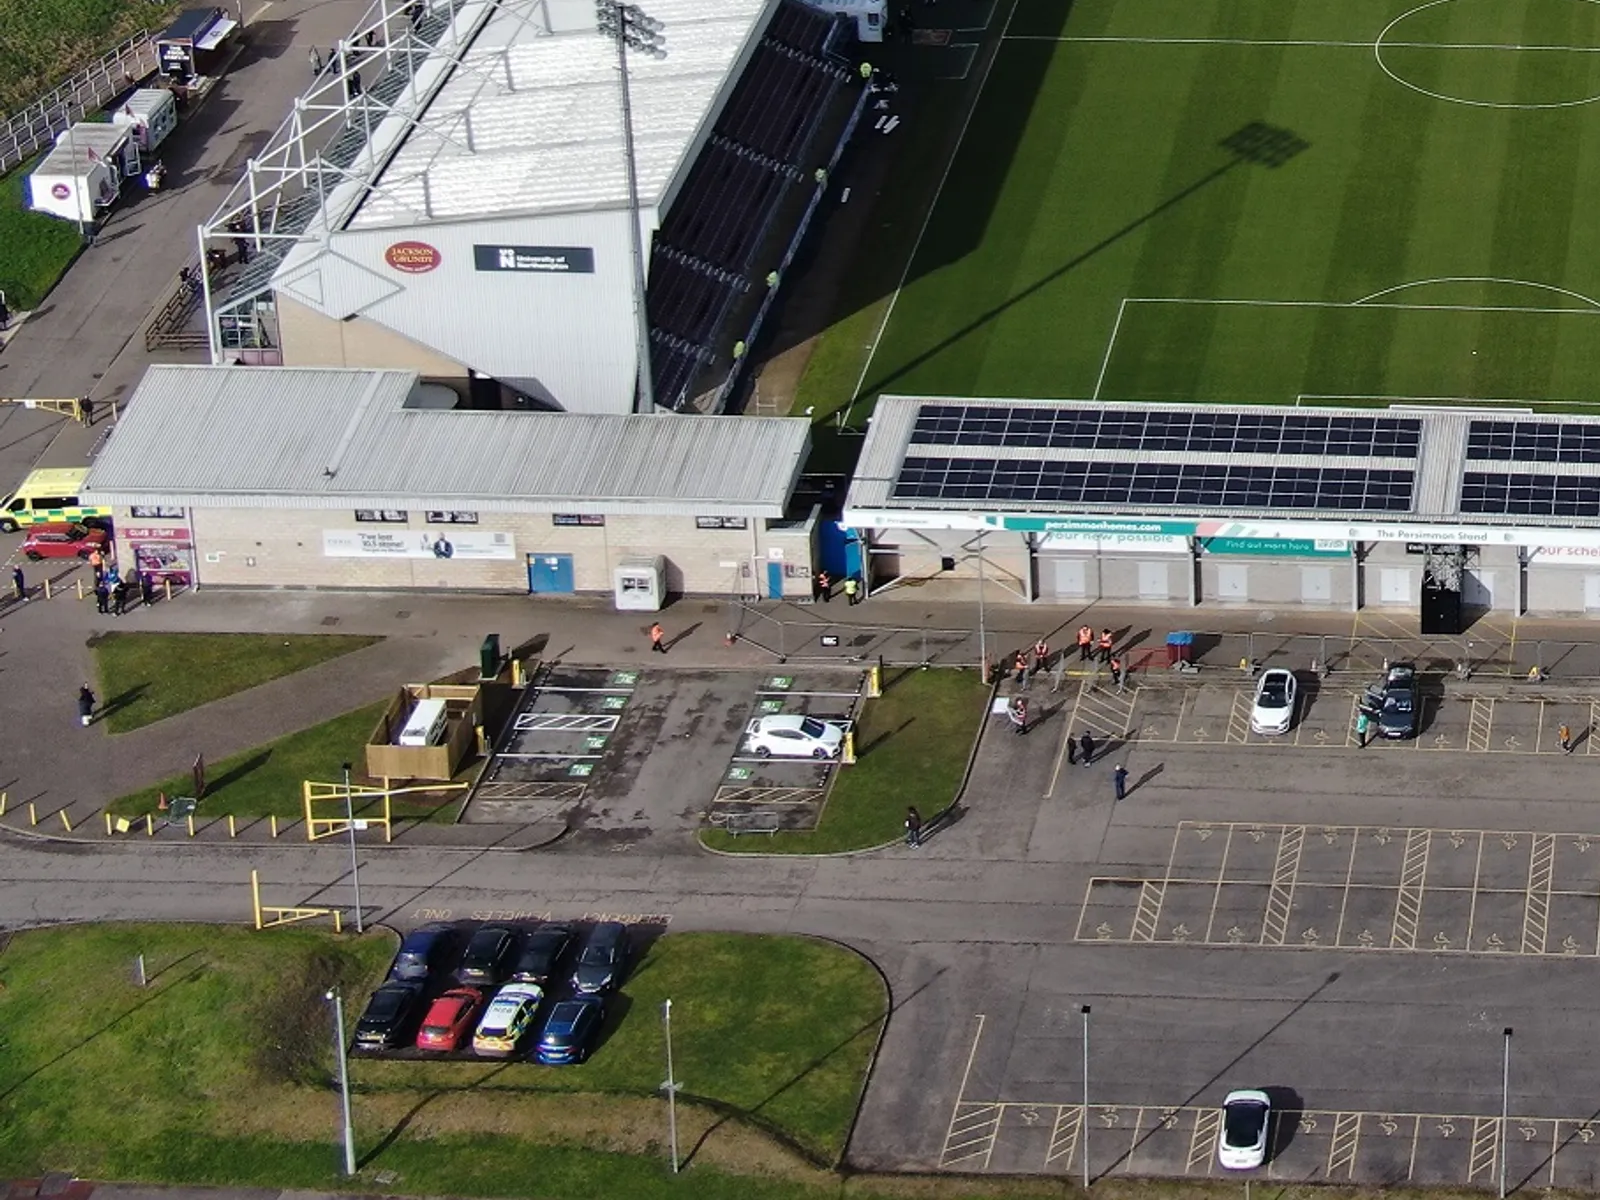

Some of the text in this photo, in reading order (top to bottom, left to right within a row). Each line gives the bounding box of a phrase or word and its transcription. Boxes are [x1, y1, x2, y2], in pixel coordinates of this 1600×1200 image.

[392, 248, 433, 256] JACKSON
[517, 255, 555, 263] University
[517, 262, 569, 270] Northampton
[1045, 520, 1161, 533] persimmonhomes.com
[1079, 533, 1113, 541] new
[1117, 532, 1174, 543] possible
[1377, 529, 1488, 541] The Persimmon Stand
[1225, 540, 1245, 549] Find
[1248, 540, 1262, 549] out
[1264, 542, 1286, 550] more
[411, 909, 674, 925] EMERGENCY VEHICLES ONLY
